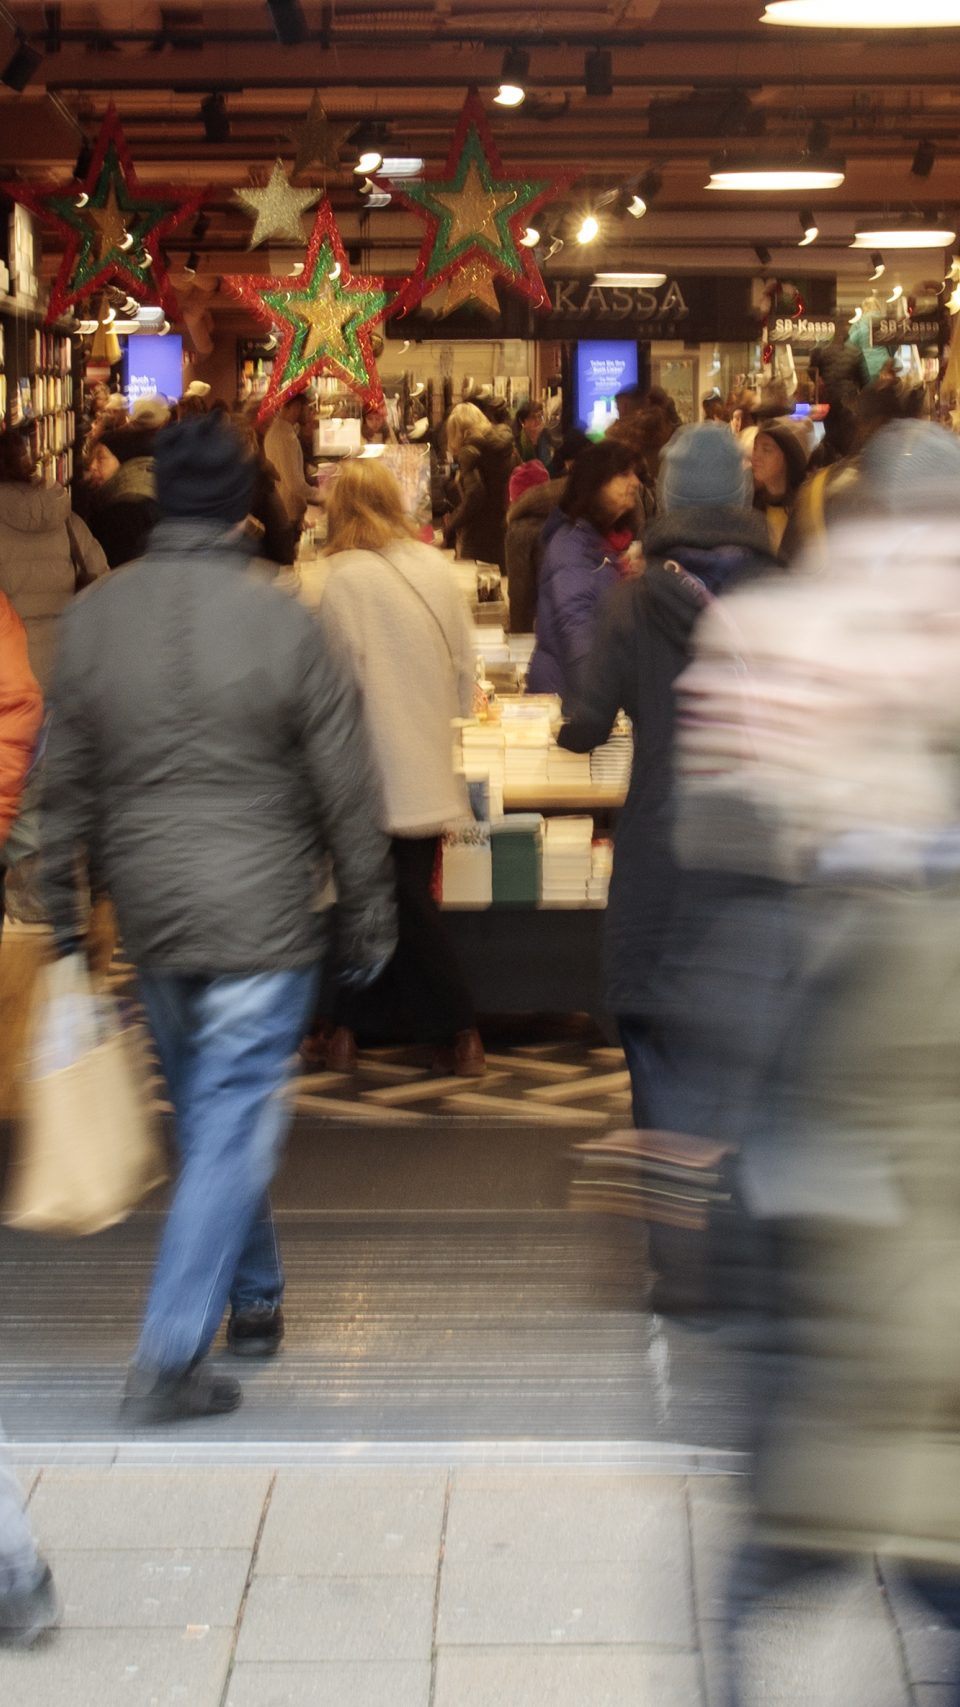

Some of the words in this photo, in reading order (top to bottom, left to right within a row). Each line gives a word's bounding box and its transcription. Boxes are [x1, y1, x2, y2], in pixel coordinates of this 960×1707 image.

[553, 280, 689, 313] KASSA
[775, 319, 836, 333] SB-Kassa
[879, 319, 940, 332] SB-Kassa
